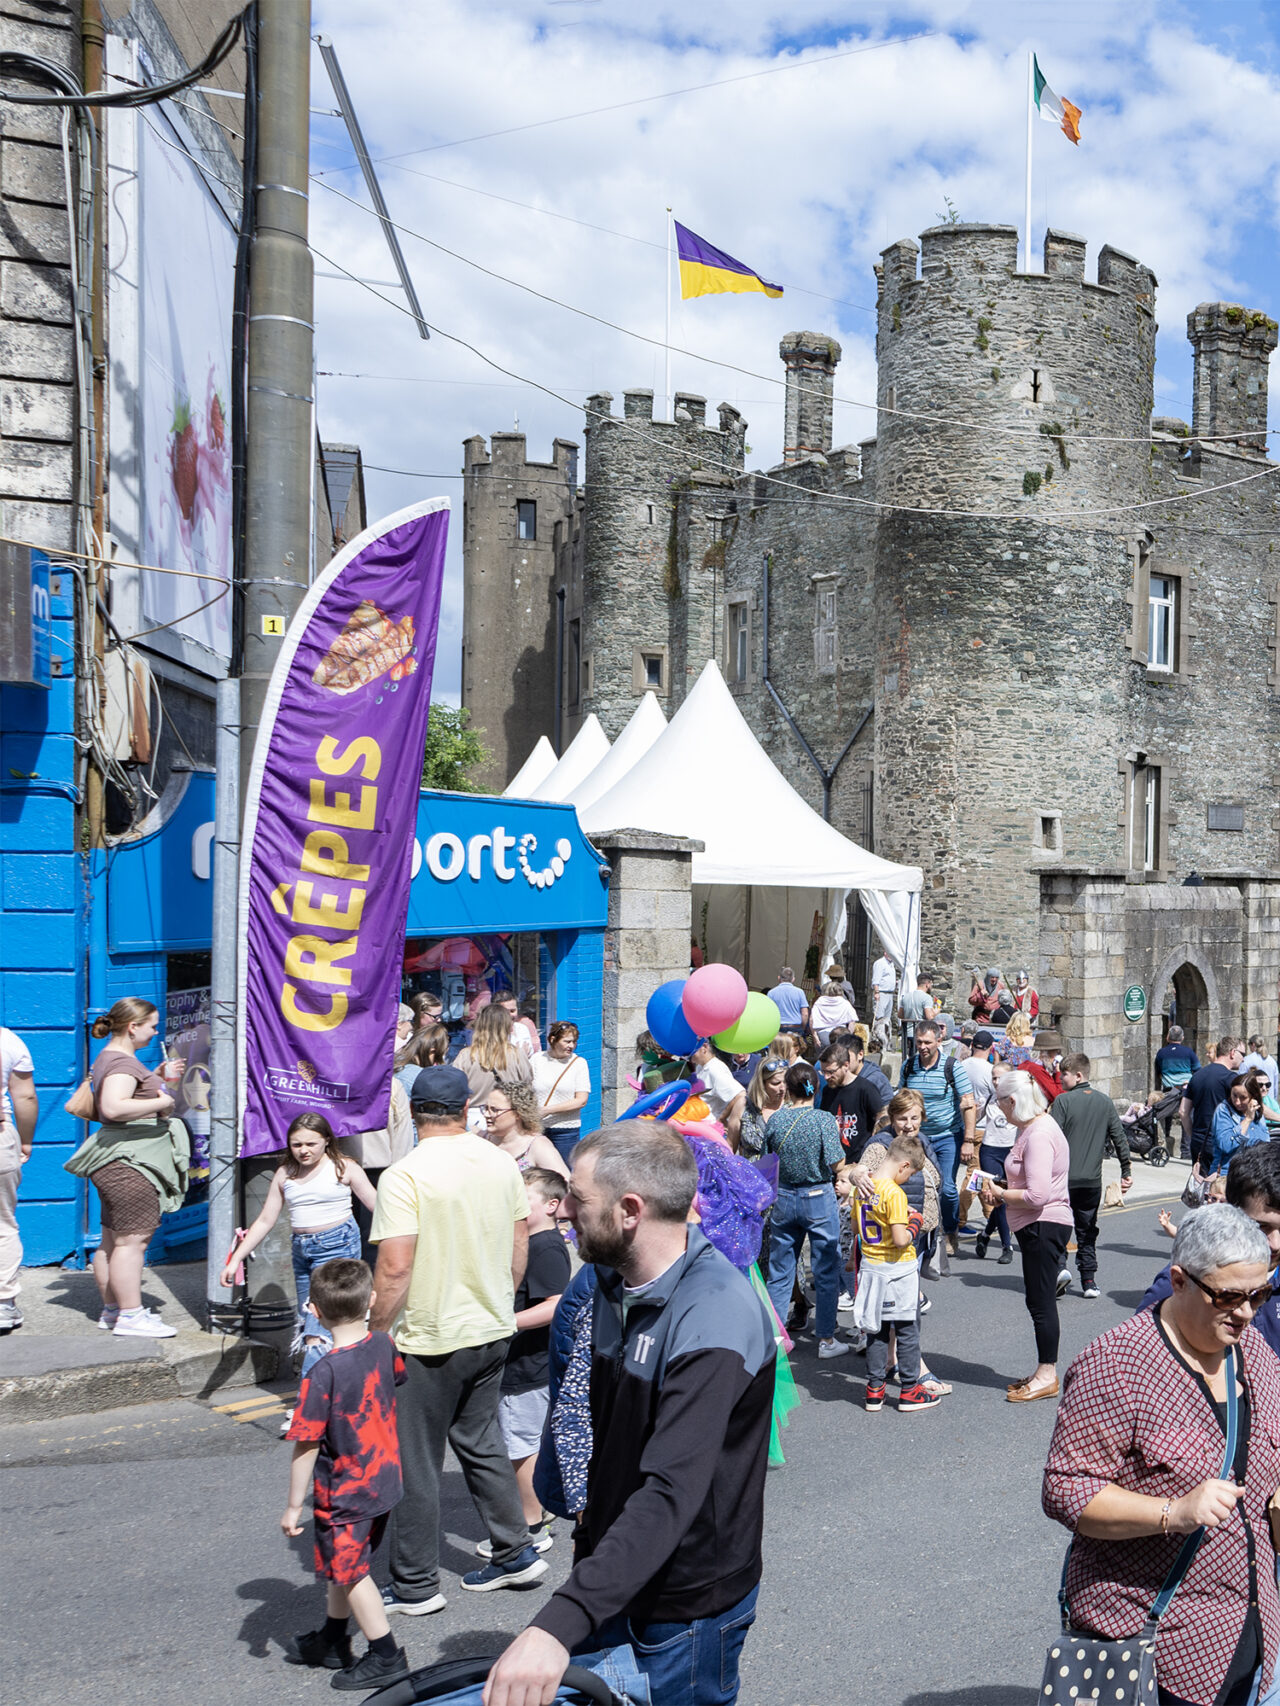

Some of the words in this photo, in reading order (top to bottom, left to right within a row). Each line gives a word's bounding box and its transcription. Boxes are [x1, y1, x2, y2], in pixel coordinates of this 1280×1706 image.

[268, 619, 278, 633] 1
[270, 734, 382, 1032] CRÊPES
[166, 991, 197, 1009] rophy
[166, 1009, 211, 1029] ngraving
[165, 1031, 198, 1045] ervice
[861, 1203, 882, 1244] 6
